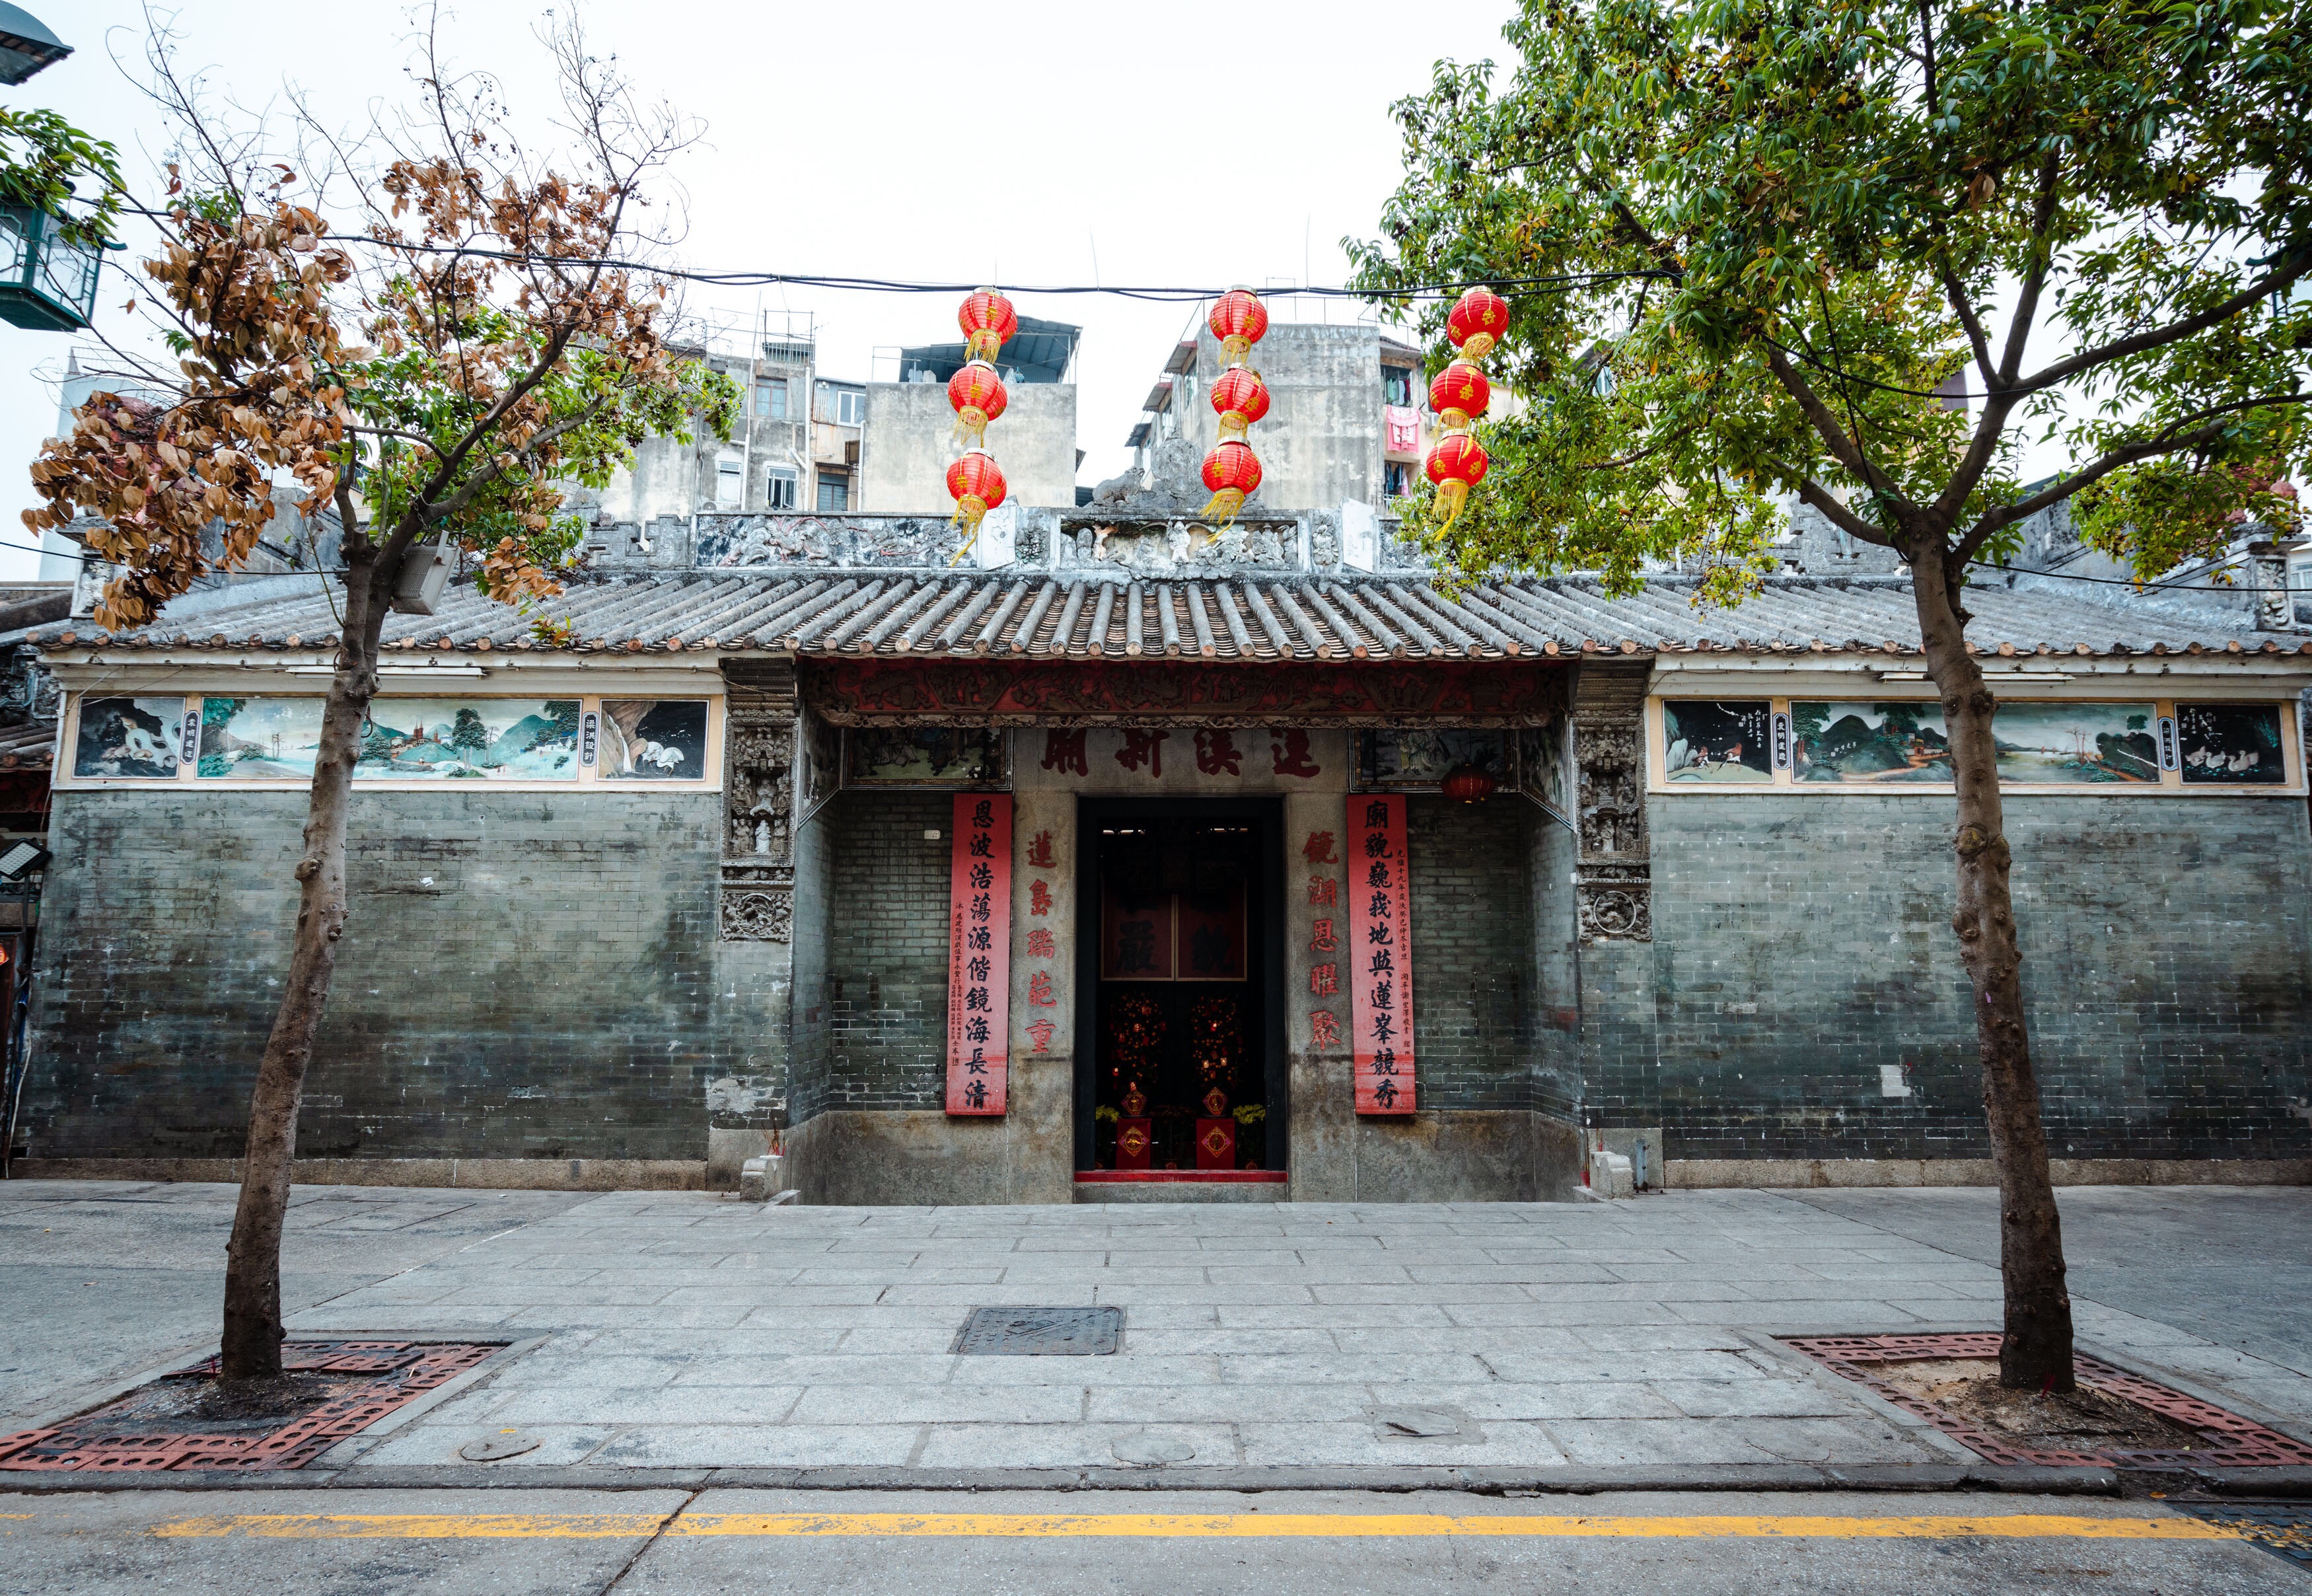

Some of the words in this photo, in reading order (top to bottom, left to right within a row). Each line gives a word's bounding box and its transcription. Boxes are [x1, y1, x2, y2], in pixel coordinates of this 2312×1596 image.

[585, 719, 595, 760] 梁洪設計
[964, 799, 995, 1110] 恩波浩蕩源偕鏡海長清
